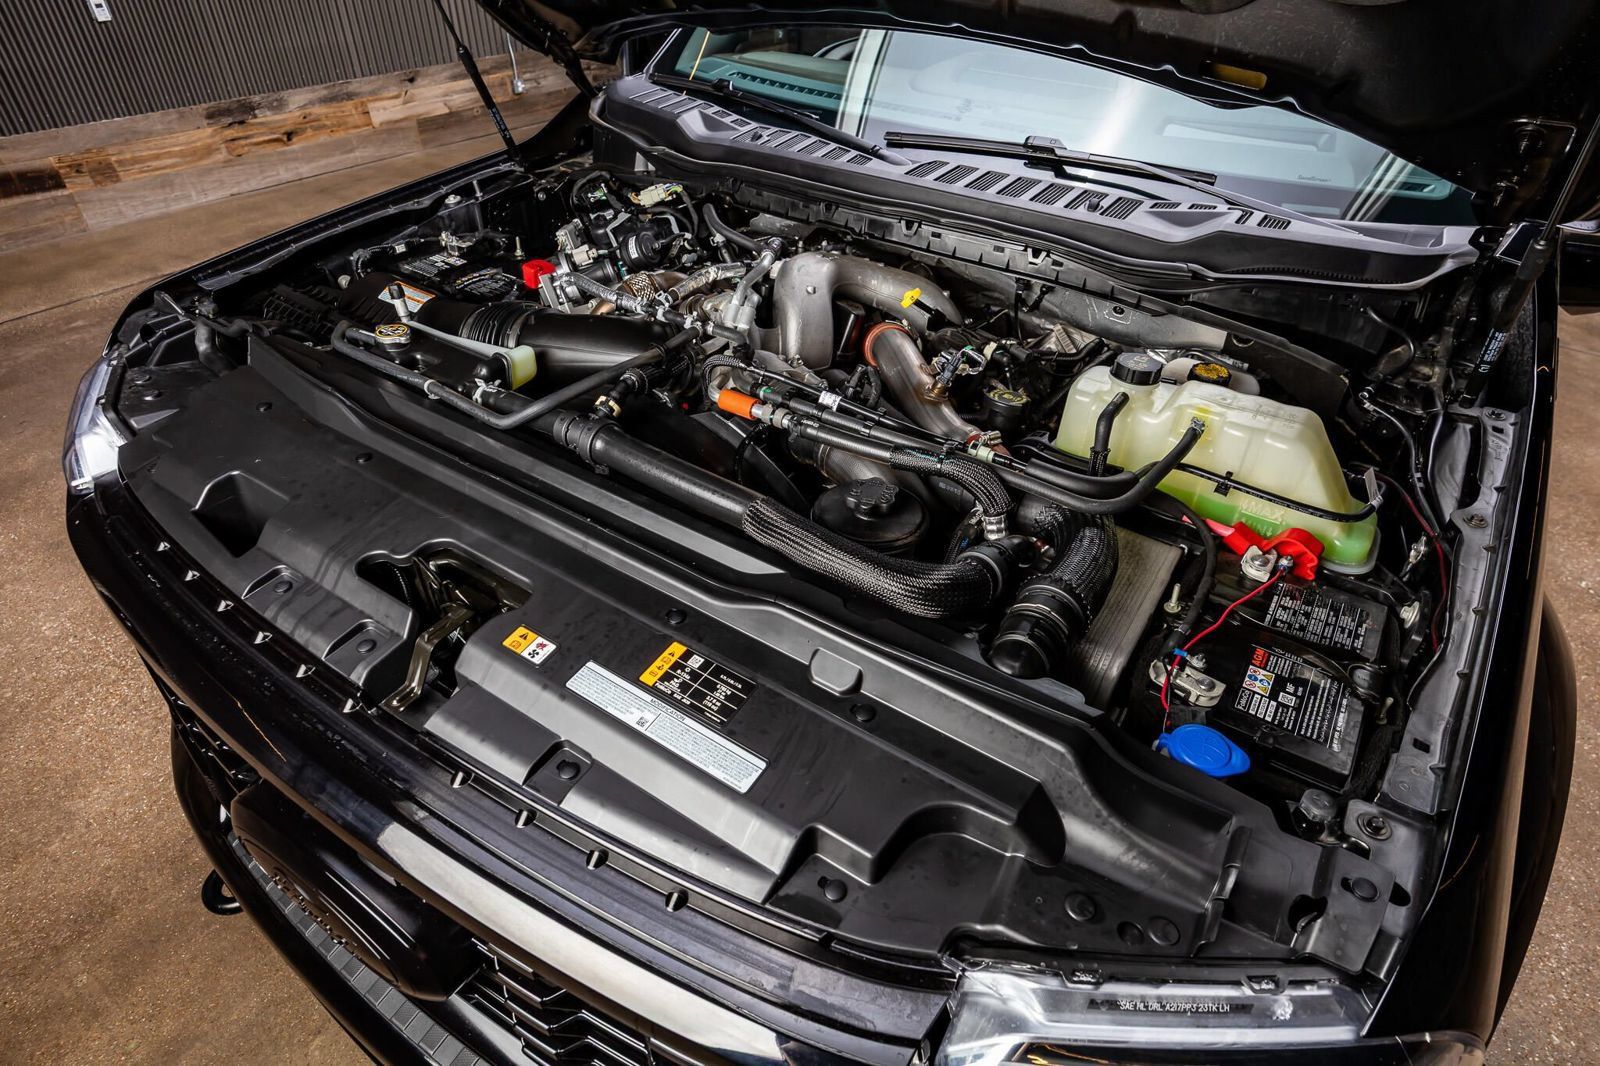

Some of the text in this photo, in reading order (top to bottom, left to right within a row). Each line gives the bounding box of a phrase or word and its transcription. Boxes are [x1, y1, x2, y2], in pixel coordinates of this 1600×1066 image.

[1251, 647, 1265, 666] AGM
[1237, 690, 1250, 709] FoMoCo
[650, 698, 687, 722] MODIFICATION
[1120, 1000, 1135, 1010] SAE
[1136, 1001, 1146, 1011] HL
[1148, 1002, 1163, 1011] DRL
[1198, 1003, 1217, 1012] 23TK
[1219, 1003, 1230, 1012] LH
